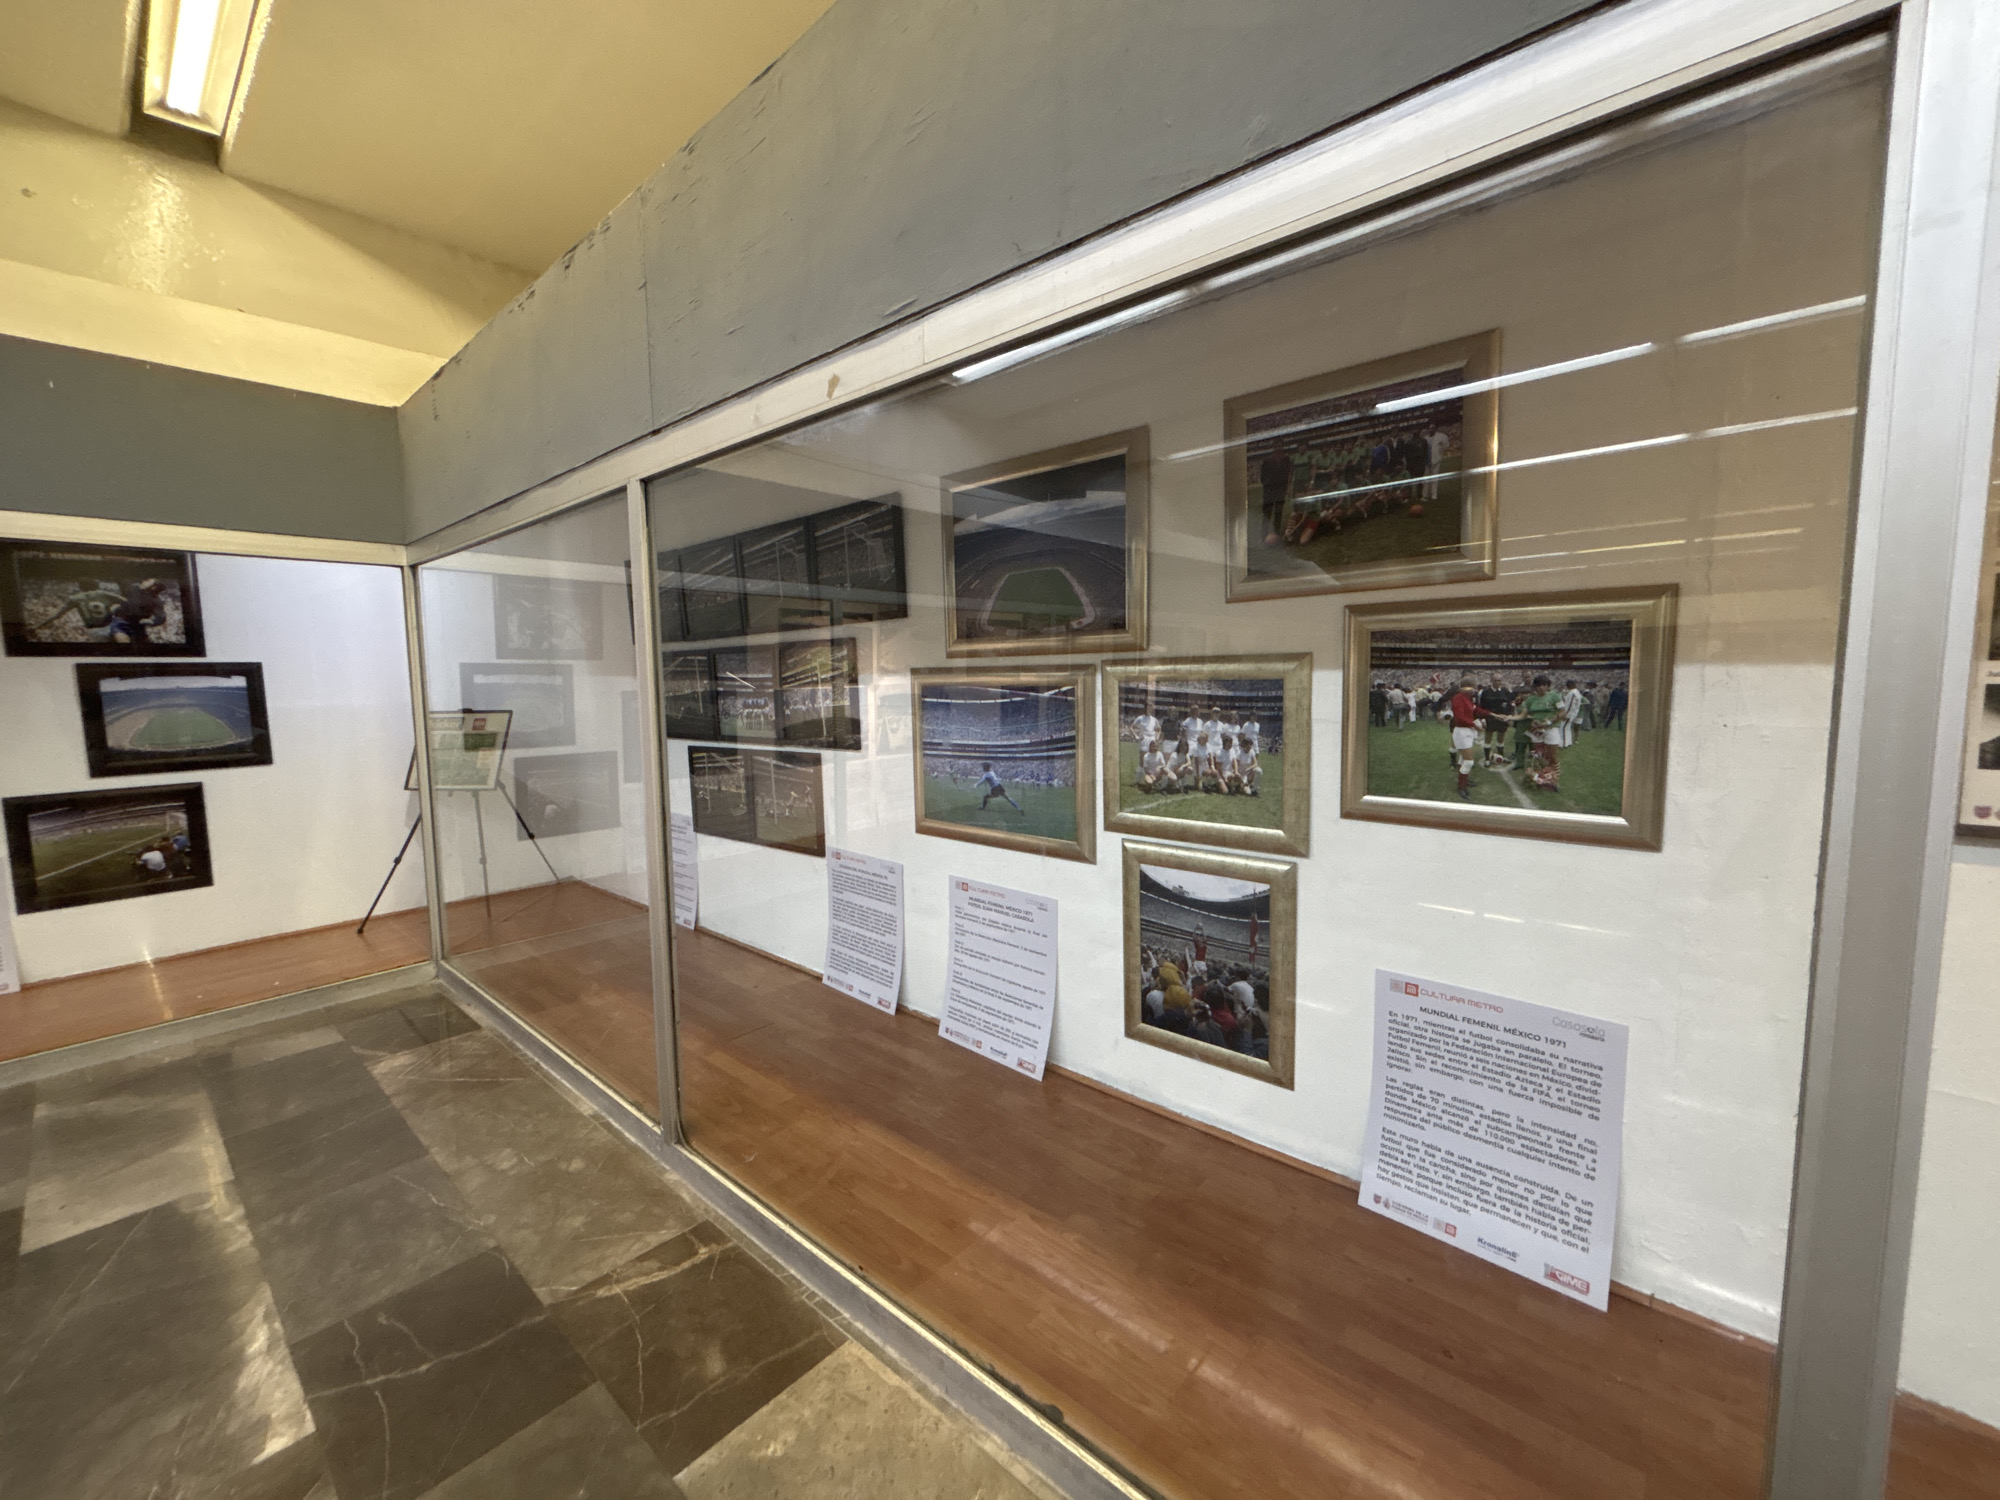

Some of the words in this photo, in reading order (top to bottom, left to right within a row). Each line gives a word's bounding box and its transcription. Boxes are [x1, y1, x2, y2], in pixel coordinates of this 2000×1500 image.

[1418, 1005, 1460, 1022] MUNDIAL
[1460, 1015, 1501, 1032] FEMENIL
[1502, 1024, 1542, 1042] MÉXICO
[1543, 1035, 1567, 1049] 1971
[1419, 987, 1466, 1006] CULTURA
[1466, 998, 1504, 1015] METRO
[1386, 1030, 1411, 1044] Futbol
[1474, 1055, 1490, 1066] seis
[1490, 1059, 1528, 1076] naciones
[1386, 1024, 1428, 1042] organizado
[1427, 1035, 1442, 1045] por
[1493, 1052, 1550, 1074] Internacional
[1549, 1067, 1589, 1086] Europea
[1412, 1023, 1429, 1033] otra
[1430, 1027, 1460, 1042] historia
[1472, 1038, 1502, 1054] jugaba
[1421, 1018, 1456, 1033] mientras
[1467, 1029, 1493, 1043] futbol
[1494, 1036, 1546, 1056] consolidaba
[1562, 1054, 1604, 1072] narrativa
[1386, 1038, 1408, 1050] iendo
[1408, 1045, 1422, 1054] sus
[1423, 1048, 1446, 1061] sedes
[1446, 1055, 1469, 1067] entre
[1480, 1064, 1512, 1080] Estadio
[1513, 1073, 1544, 1088] Azteca
[1566, 1088, 1602, 1105] Estadio
[1413, 1060, 1426, 1070] sin
[1467, 1077, 1484, 1088] con
[1486, 1082, 1504, 1093] una
[1507, 1087, 1535, 1102] fuerza
[1537, 1097, 1583, 1118] imposible
[1414, 1053, 1428, 1063] Sin
[1440, 1060, 1502, 1085] reconocimiento
[1569, 1098, 1601, 1114] torneo
[1383, 1095, 1422, 1115] Dinamarca
[1425, 1110, 1444, 1122] ante
[1383, 1088, 1408, 1102] donde
[1485, 1121, 1554, 1151] subcampeonato
[1557, 1144, 1586, 1161] frente
[1384, 1074, 1398, 1084] Las
[1401, 1079, 1424, 1093] reglas
[1427, 1088, 1446, 1099] eran
[1490, 1107, 1511, 1120] pero
[1529, 1119, 1577, 1141] intensidad
[1384, 1081, 1414, 1097] partidos
[1477, 1110, 1513, 1128] estadios
[1554, 1136, 1574, 1148] una
[1576, 1141, 1598, 1156] final
[1380, 1125, 1397, 1137] Este
[1398, 1132, 1419, 1145] muro
[1420, 1139, 1442, 1153] habla
[1456, 1153, 1473, 1164] una
[1474, 1159, 1511, 1178] ausencia
[1382, 1103, 1418, 1122] respuesta
[1418, 1114, 1431, 1126] del
[1505, 1144, 1546, 1166] cualquier
[1547, 1158, 1581, 1177] intento
[1380, 1133, 1403, 1147] futbol
[1404, 1143, 1420, 1155] que
[1422, 1148, 1437, 1160] fue
[1439, 1154, 1488, 1178] considerado
[1490, 1173, 1519, 1190] menor
[1538, 1191, 1556, 1205] por
[1573, 1204, 1593, 1219] que
[1399, 1157, 1412, 1167] ser
[1440, 1171, 1453, 1182] sin
[1530, 1205, 1557, 1222] habla
[1402, 1182, 1438, 1203] reclaman
[1415, 1171, 1444, 1188] porque
[1444, 1181, 1474, 1199] incluso
[1475, 1192, 1497, 1208] fuera
[1523, 1212, 1558, 1232] historia
[1459, 1169, 1477, 1183] sino
[1478, 1177, 1494, 1190] por
[1495, 1183, 1530, 1204] quienes
[1389, 1169, 1414, 1185] gestos
[1413, 1179, 1430, 1192] que
[1461, 1197, 1479, 1211] que
[1478, 1204, 1532, 1231] permanecen
[1560, 1236, 1579, 1250] con
